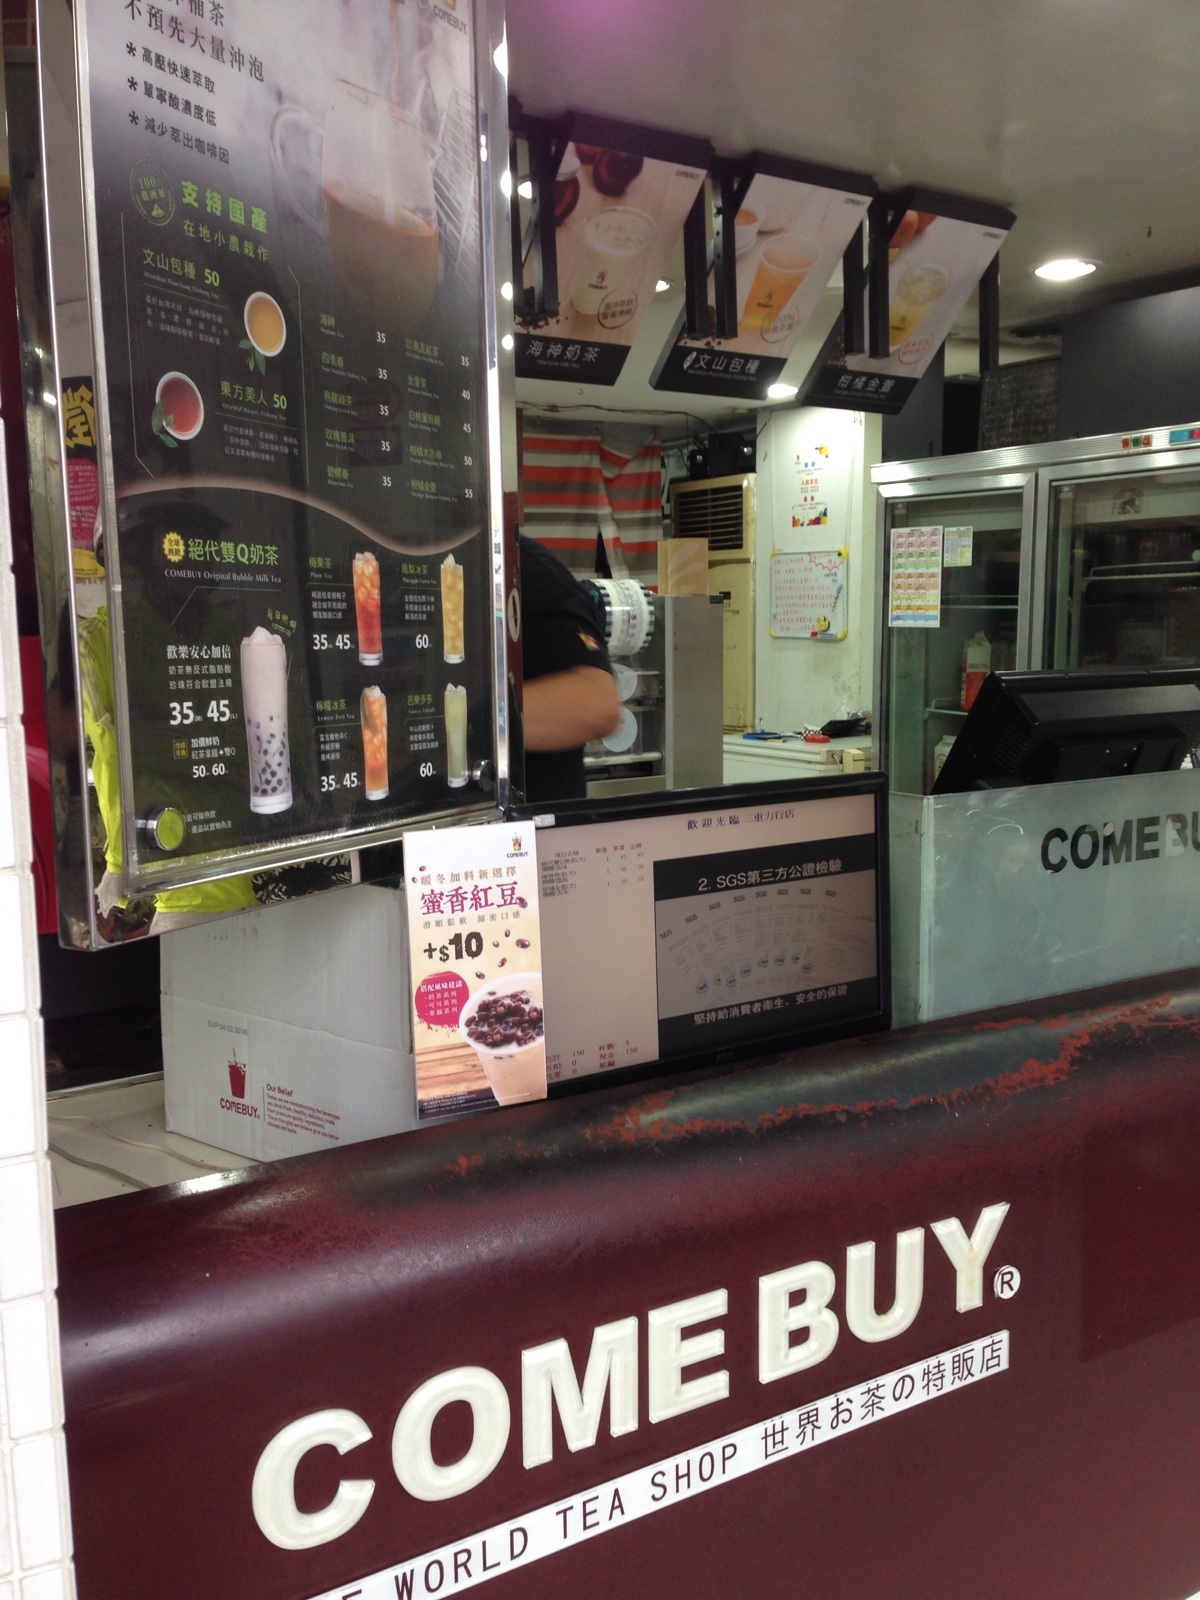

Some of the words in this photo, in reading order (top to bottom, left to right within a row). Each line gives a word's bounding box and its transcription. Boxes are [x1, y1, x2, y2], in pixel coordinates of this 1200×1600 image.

[142, 47, 216, 95] 高壓快速萃取
[143, 81, 217, 127] 單寧酸濃度低
[145, 116, 229, 164] 減少萃出咖啡因
[181, 180, 267, 233] 支持國產
[184, 219, 269, 262] 在地小農栽作
[143, 248, 196, 280] 文山包種
[204, 268, 220, 287] 50
[377, 331, 387, 344] 35
[526, 340, 600, 363] 海神奶茶
[322, 351, 344, 369] 四季春
[460, 356, 470, 368] 35
[695, 353, 760, 374] 文山包種
[378, 367, 388, 381] 35
[837, 374, 896, 393] 柑橘金萱
[220, 380, 267, 406] 東方美人
[273, 393, 287, 410] 50
[462, 389, 471, 401] 40
[380, 404, 389, 417] 35
[325, 428, 355, 444] 玫瑰普洱
[463, 422, 472, 435] 45
[381, 440, 391, 452] 35
[464, 456, 473, 468] 50
[382, 476, 392, 488] 35
[465, 488, 474, 500] 55
[188, 538, 279, 566] 絕代雙Q奶茶
[164, 568, 202, 580] COMEBUY
[203, 570, 231, 583] Original
[232, 572, 254, 583] Bubble
[255, 574, 270, 584] Milk
[271, 575, 282, 584] Tea
[312, 634, 328, 650] 35
[335, 634, 351, 650] 45
[416, 634, 429, 649] 60
[167, 644, 232, 660] 歡樂安心加倍
[169, 664, 232, 675] 奶茶無反式脂肪酸
[169, 702, 194, 726] 35
[207, 700, 231, 723] 45
[193, 765, 206, 779] 50
[212, 763, 226, 776] 60
[420, 762, 433, 778] 60
[321, 775, 336, 792] 35
[343, 772, 358, 788] 45
[687, 816, 740, 831] 歡迎光臨
[744, 808, 796, 822] 三重力行店
[506, 851, 529, 859] COMEBUY
[421, 866, 516, 886] 暖冬加料新選擇
[698, 878, 712, 892] 2.
[716, 858, 843, 890] SGS第三方公證檢驗
[420, 881, 518, 916] 蜜香紅豆
[709, 901, 722, 911] SGS
[733, 894, 746, 903] SGS
[685, 913, 698, 924] SGS
[420, 980, 463, 993] 搭配風味建議
[694, 984, 849, 1026] 堅持給消費者衛生、安全的保證
[573, 1049, 585, 1057] 150
[626, 1047, 638, 1055] 150
[266, 1083, 276, 1093] Our
[277, 1086, 293, 1097] Belief
[220, 1098, 259, 1119] COMEBUY
[251, 1288, 731, 1551] COME
[758, 1200, 1011, 1384] BUY
[394, 1527, 529, 1600] WORLD
[556, 1486, 627, 1541] TEA
[650, 1442, 739, 1503] SHOP
[762, 1337, 1006, 1460] 世界お茶の特販店
